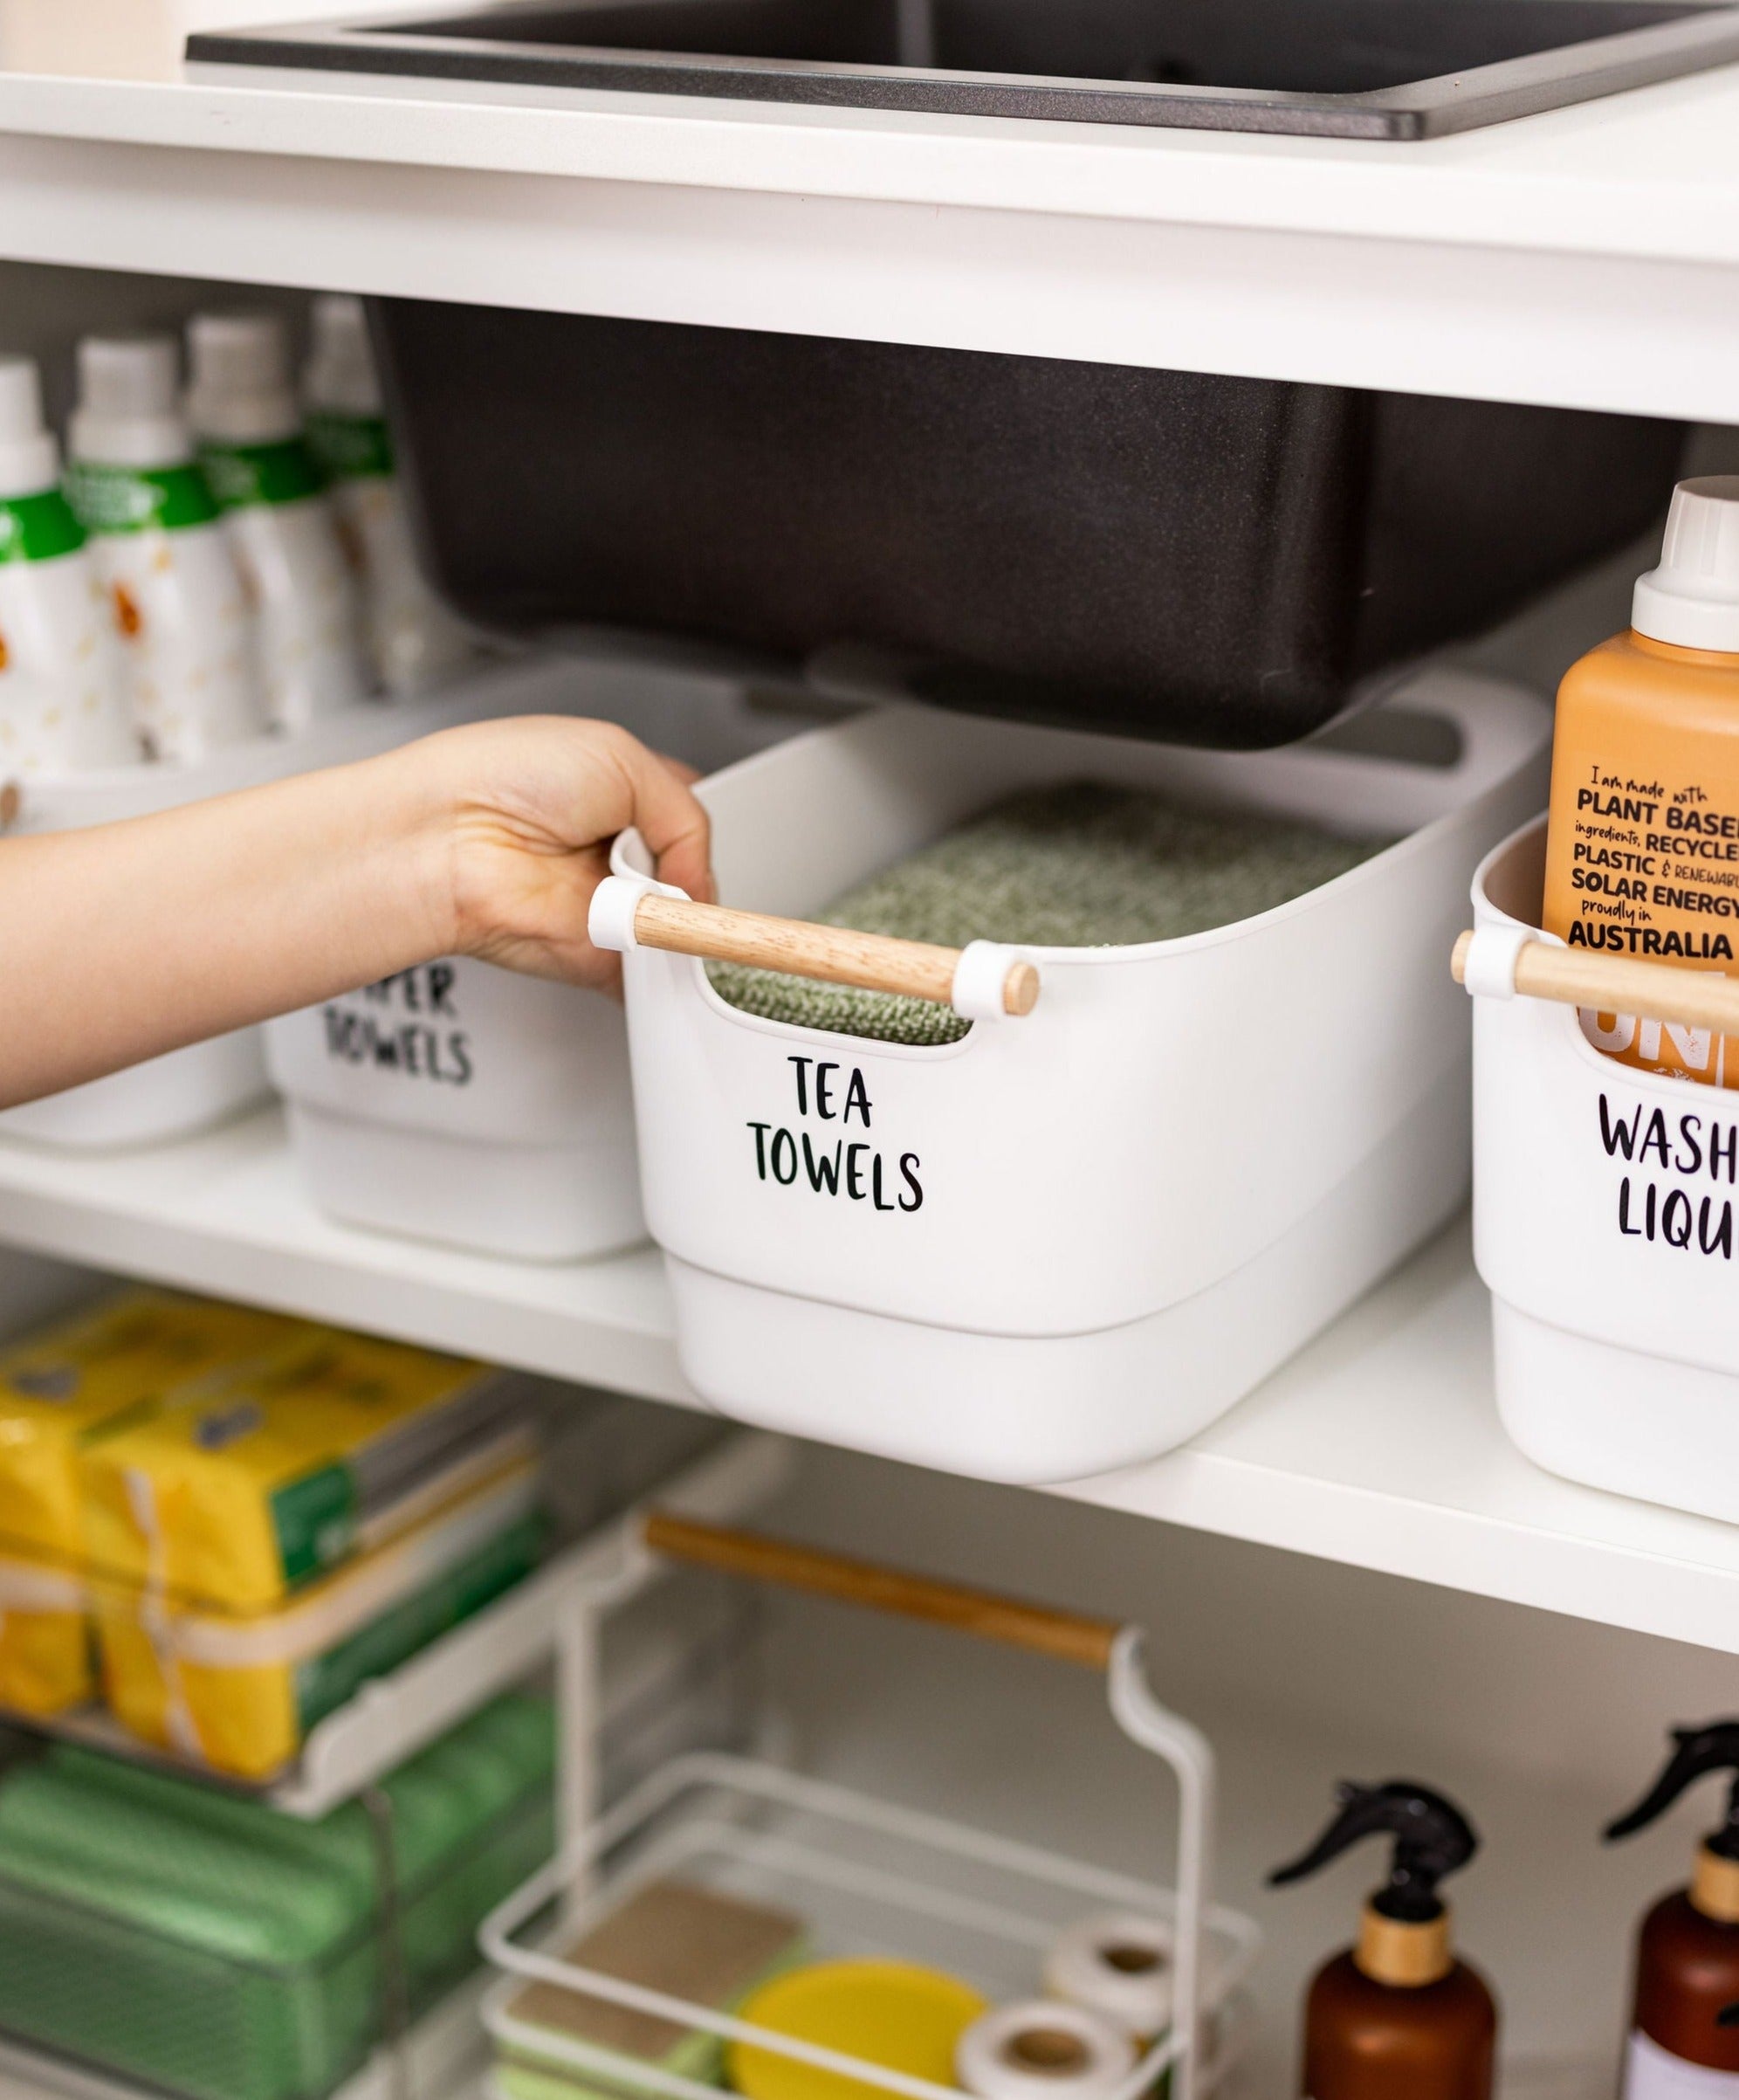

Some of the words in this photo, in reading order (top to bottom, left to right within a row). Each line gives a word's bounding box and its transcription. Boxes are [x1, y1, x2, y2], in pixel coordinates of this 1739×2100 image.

[1591, 765, 1599, 784] I
[1601, 776, 1623, 790] am
[1626, 779, 1665, 798] made
[1673, 786, 1708, 804] with
[1577, 788, 1659, 825] PLANT
[1666, 806, 1739, 839] BASE
[1574, 843, 1655, 876] PLASTIC
[1661, 859, 1671, 878] &
[1575, 820, 1640, 847] ingredients,
[1646, 833, 1738, 861] RECYCLE
[1571, 867, 1647, 902] SOLAR
[1653, 885, 1739, 919] ENERGY
[1582, 899, 1635, 926] proudly
[1639, 906, 1653, 921] in
[1568, 920, 1734, 960] AUSTRALIA
[323, 1005, 473, 1086] TOWELS
[787, 1056, 873, 1128] TEA
[1598, 1093, 1737, 1184] WASH
[746, 1122, 924, 1212] TOWELS
[1619, 1176, 1733, 1260] LIQU
